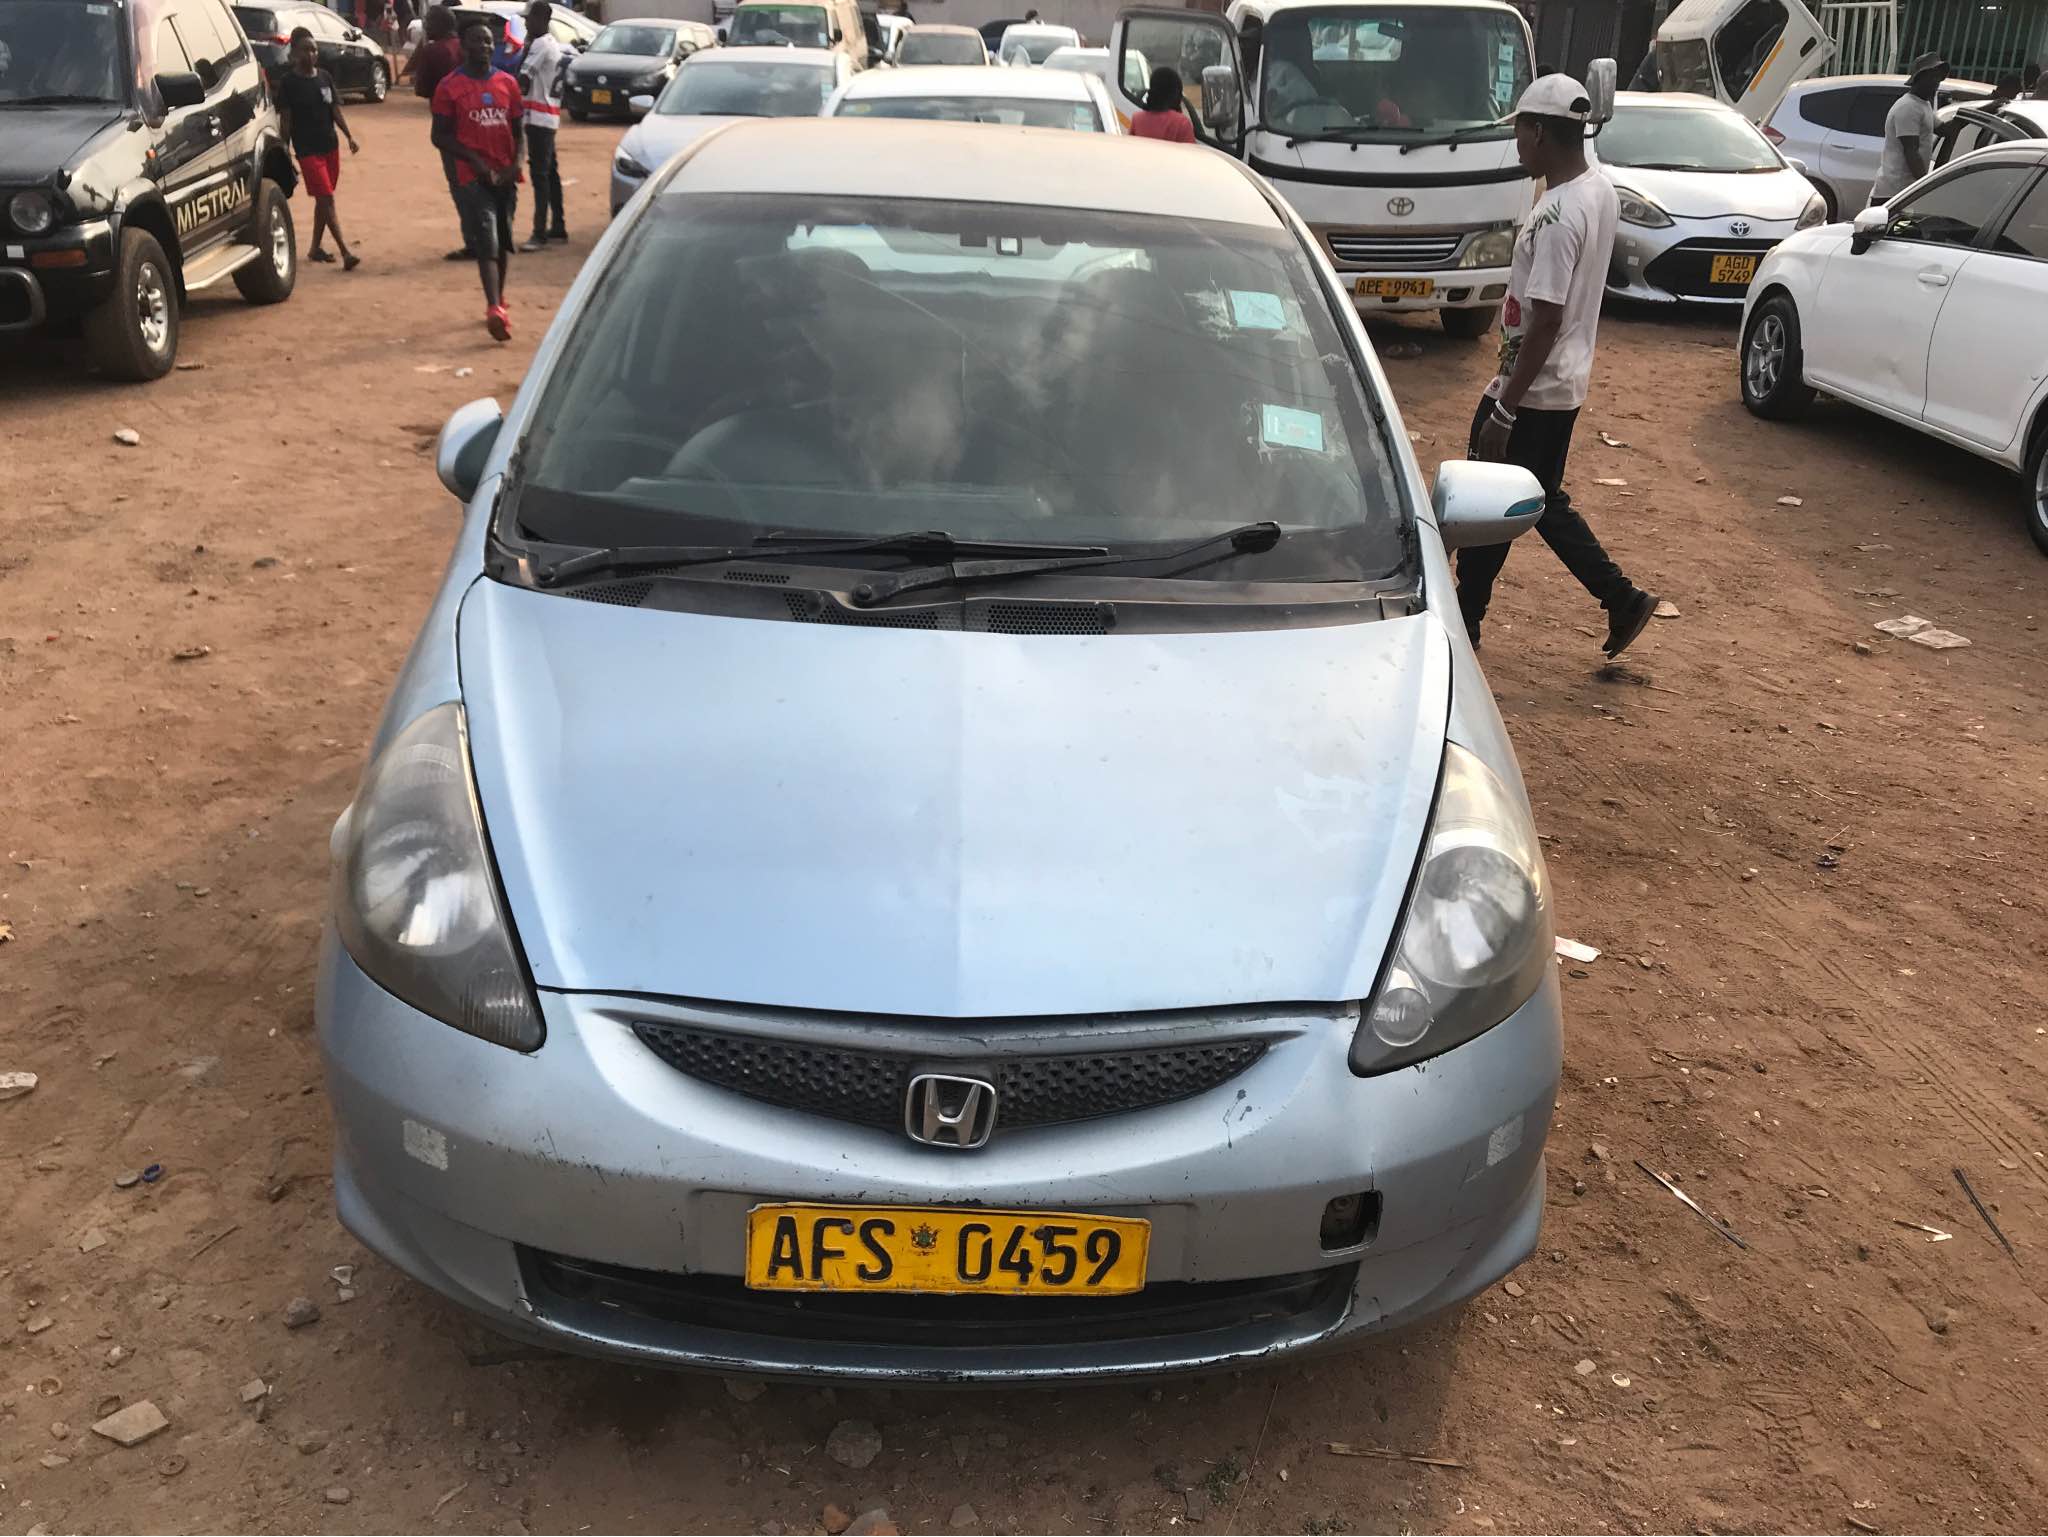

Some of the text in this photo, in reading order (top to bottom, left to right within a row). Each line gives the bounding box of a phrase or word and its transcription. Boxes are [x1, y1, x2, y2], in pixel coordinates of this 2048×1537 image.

[176, 177, 252, 236] MISTRAL
[1718, 270, 1750, 282] 5749
[1724, 256, 1750, 269] AGD
[767, 1215, 1122, 1286] AFS 0459
